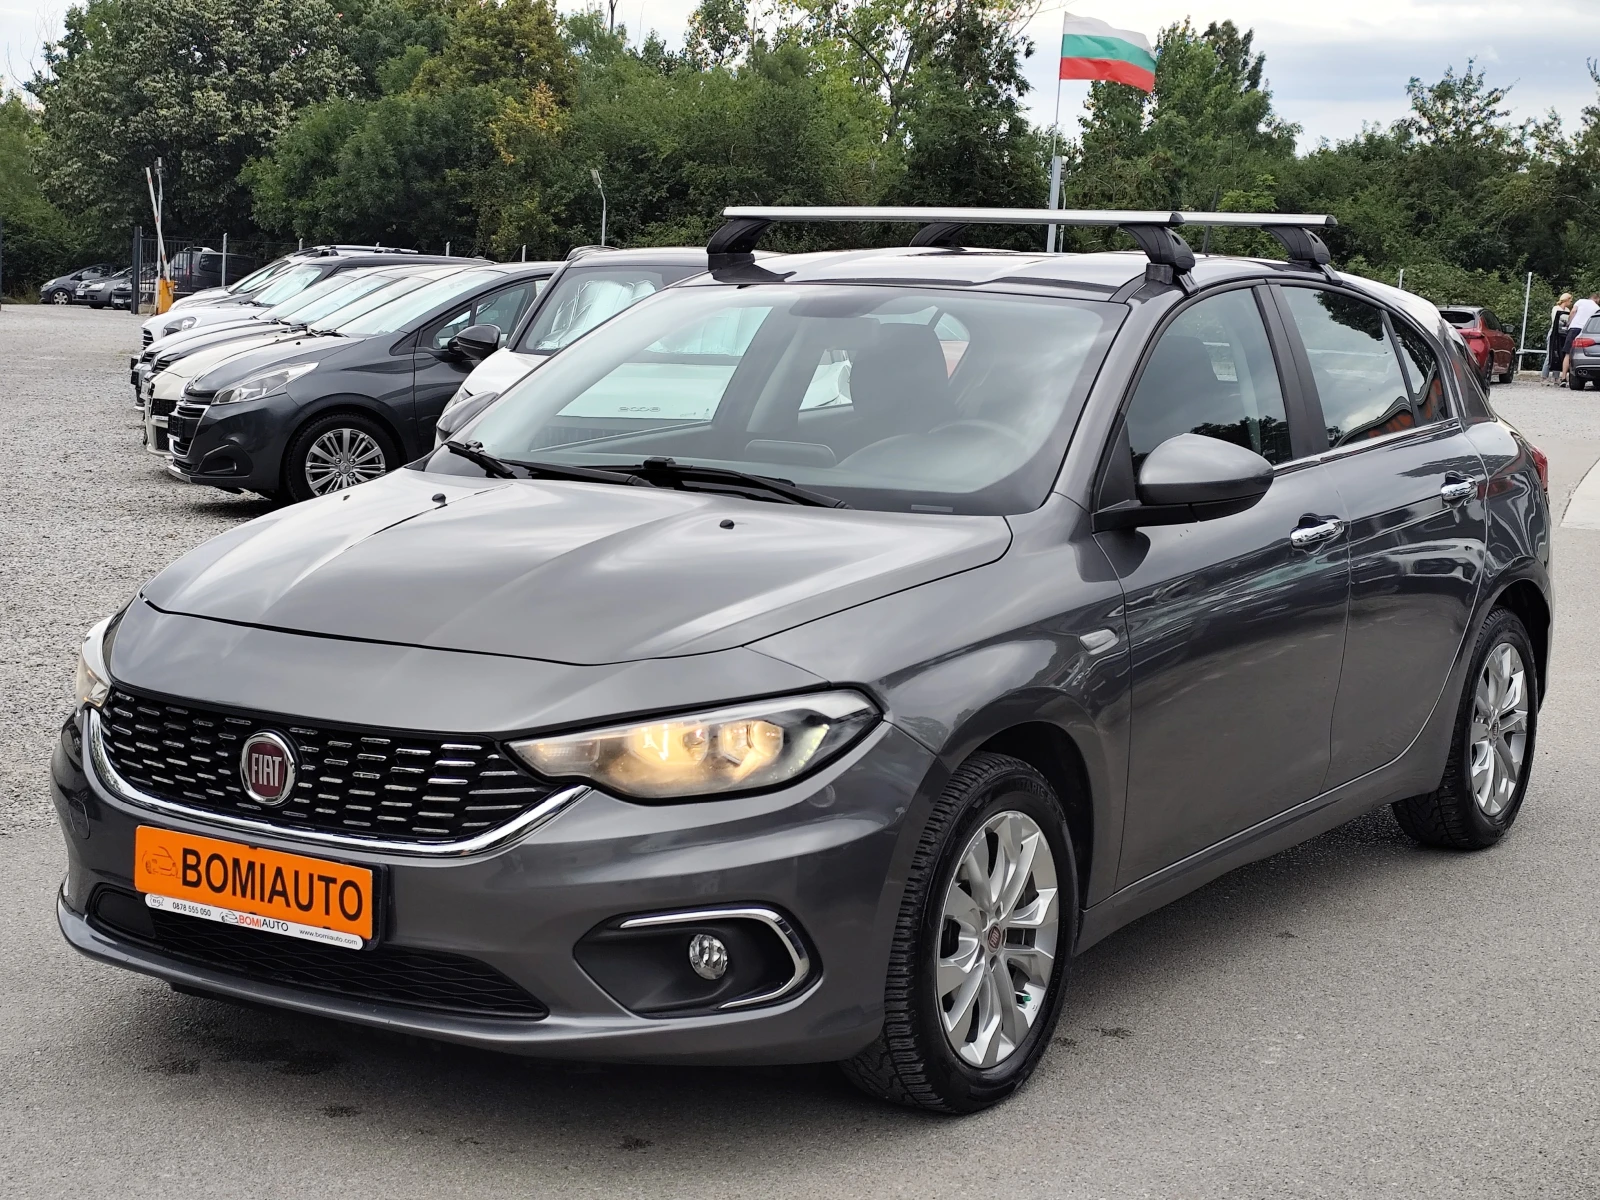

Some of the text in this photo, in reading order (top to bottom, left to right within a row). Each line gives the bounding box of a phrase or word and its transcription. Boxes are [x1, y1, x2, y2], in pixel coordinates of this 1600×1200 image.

[251, 752, 283, 788] FIAT
[181, 847, 363, 922] BOMIAUTO
[172, 901, 212, 917] 0878 555 050
[238, 914, 289, 932] BOMIAUTO
[299, 928, 358, 946] www.bomiauto.com
